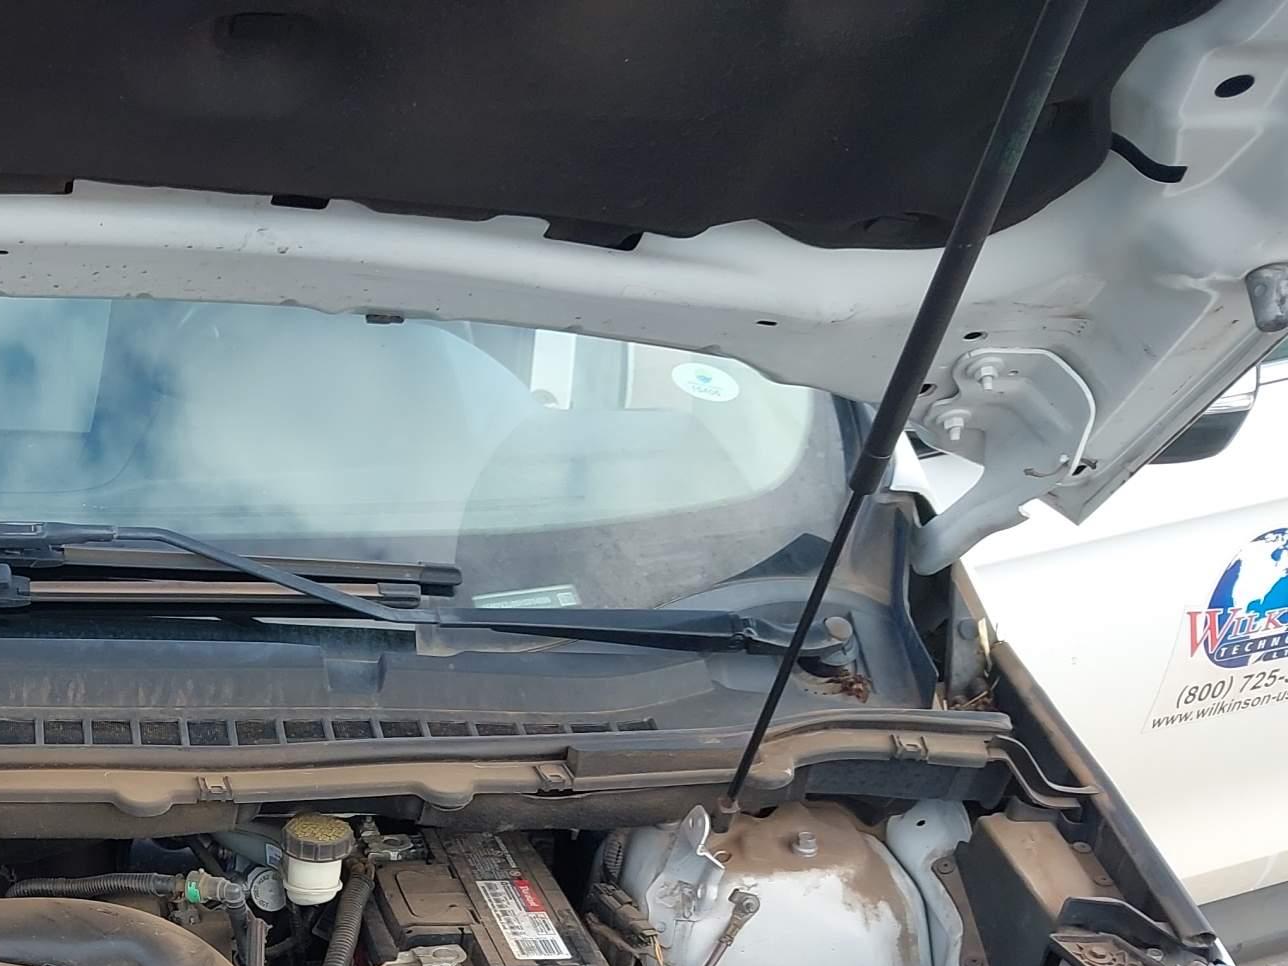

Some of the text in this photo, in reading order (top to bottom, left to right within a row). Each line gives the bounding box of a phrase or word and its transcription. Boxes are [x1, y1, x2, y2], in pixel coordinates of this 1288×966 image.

[1187, 608, 1288, 657] WILK
[1177, 668, 1288, 709] (800) 725-
